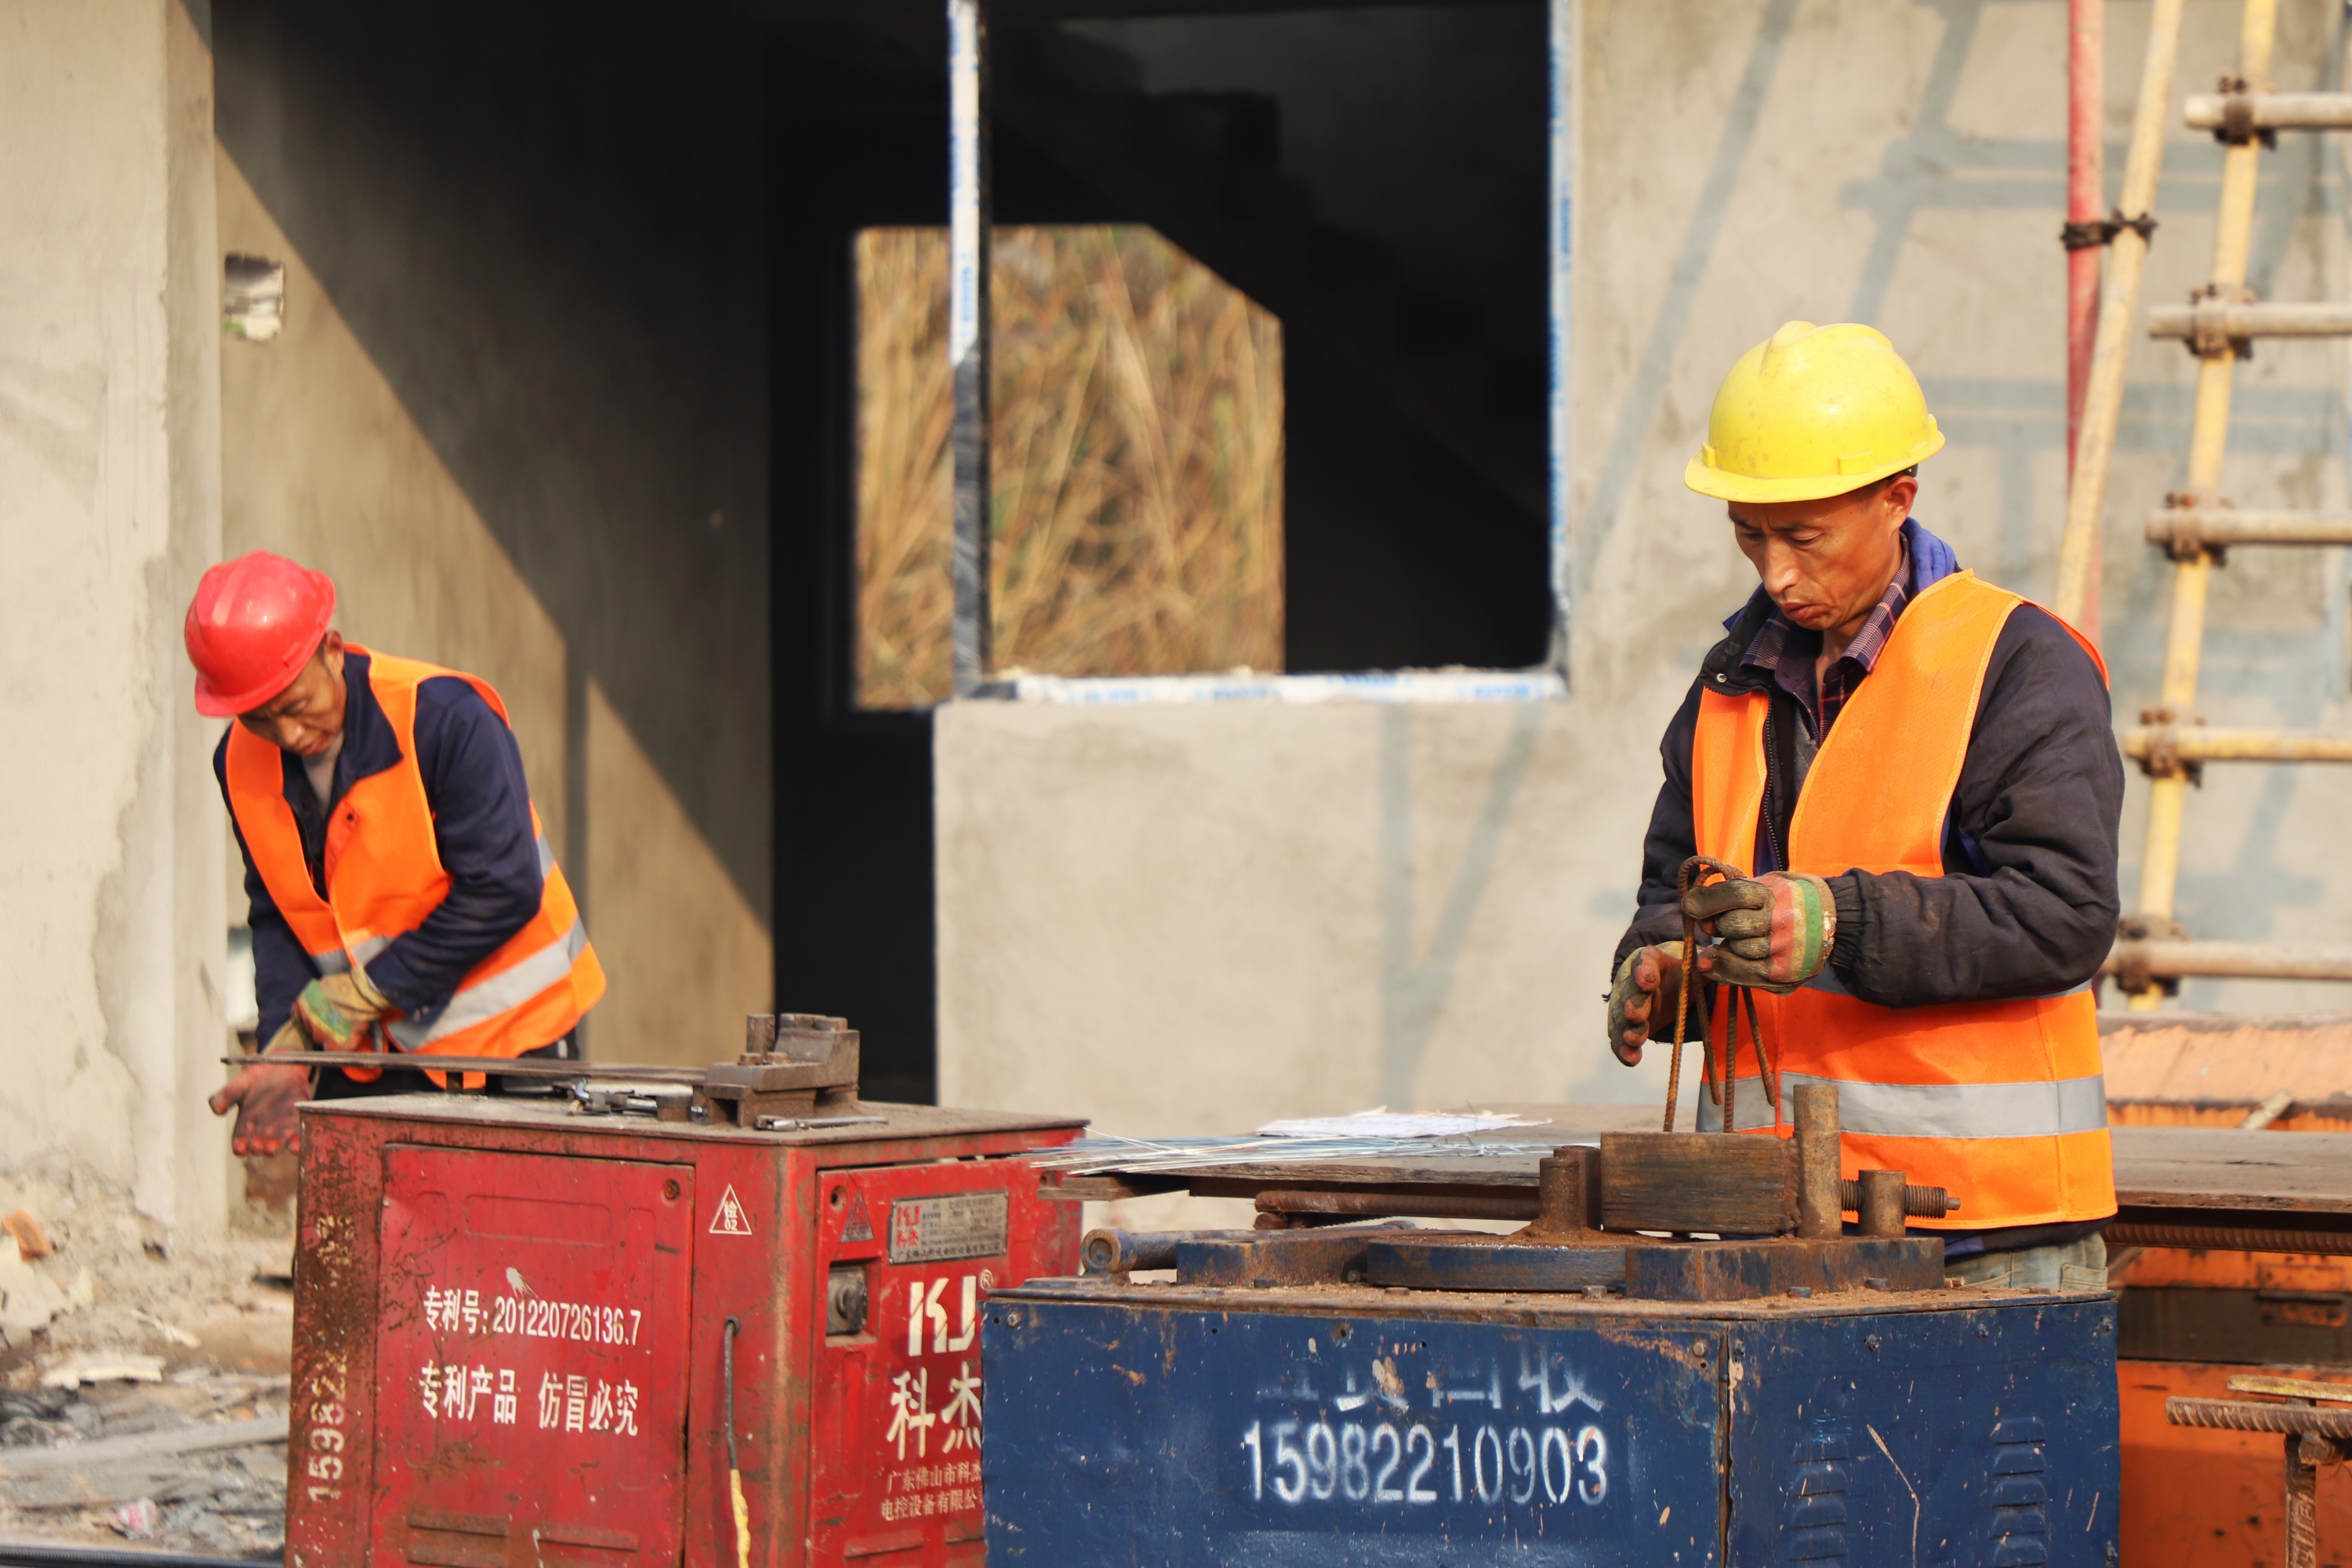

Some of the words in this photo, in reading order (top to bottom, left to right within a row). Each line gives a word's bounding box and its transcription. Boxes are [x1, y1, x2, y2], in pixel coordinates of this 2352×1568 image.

[724, 1218, 739, 1232] 02
[419, 1359, 517, 1425] 专利产品
[538, 1368, 639, 1436] 仿冒必究
[886, 1360, 982, 1461] 科杰
[1245, 1421, 1606, 1506] 15982210903
[880, 1486, 982, 1521] 电控设备有限公
